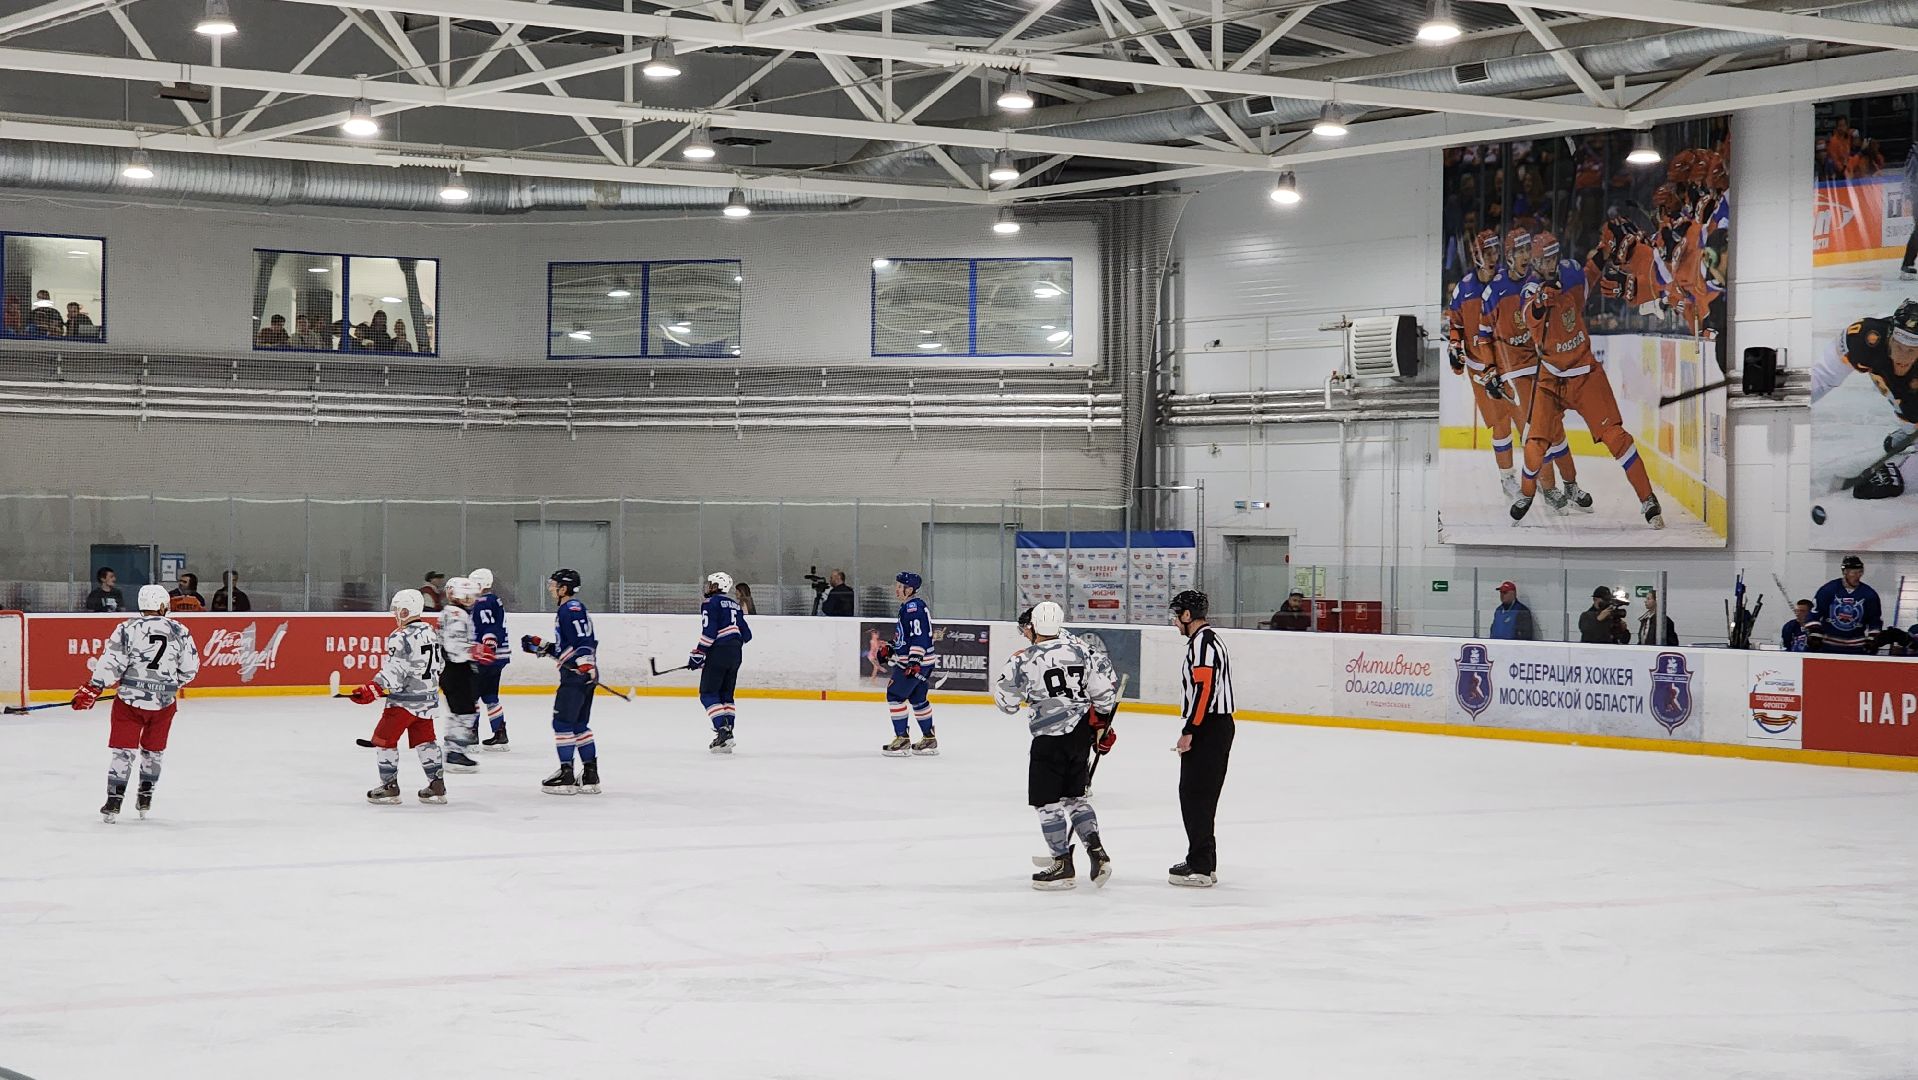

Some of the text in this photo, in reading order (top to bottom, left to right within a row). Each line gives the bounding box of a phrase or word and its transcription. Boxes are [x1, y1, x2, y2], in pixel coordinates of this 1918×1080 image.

[147, 634, 168, 670] 7
[943, 655, 988, 669] КАТАНИЕ
[1345, 651, 1432, 677] Активное
[1509, 663, 1633, 686] ФЕДЕРАЦИЯ ХОККЕЯ
[1500, 687, 1581, 709] МОСКОВСКОЙ
[1585, 693, 1643, 714] ОБЛАСТИ
